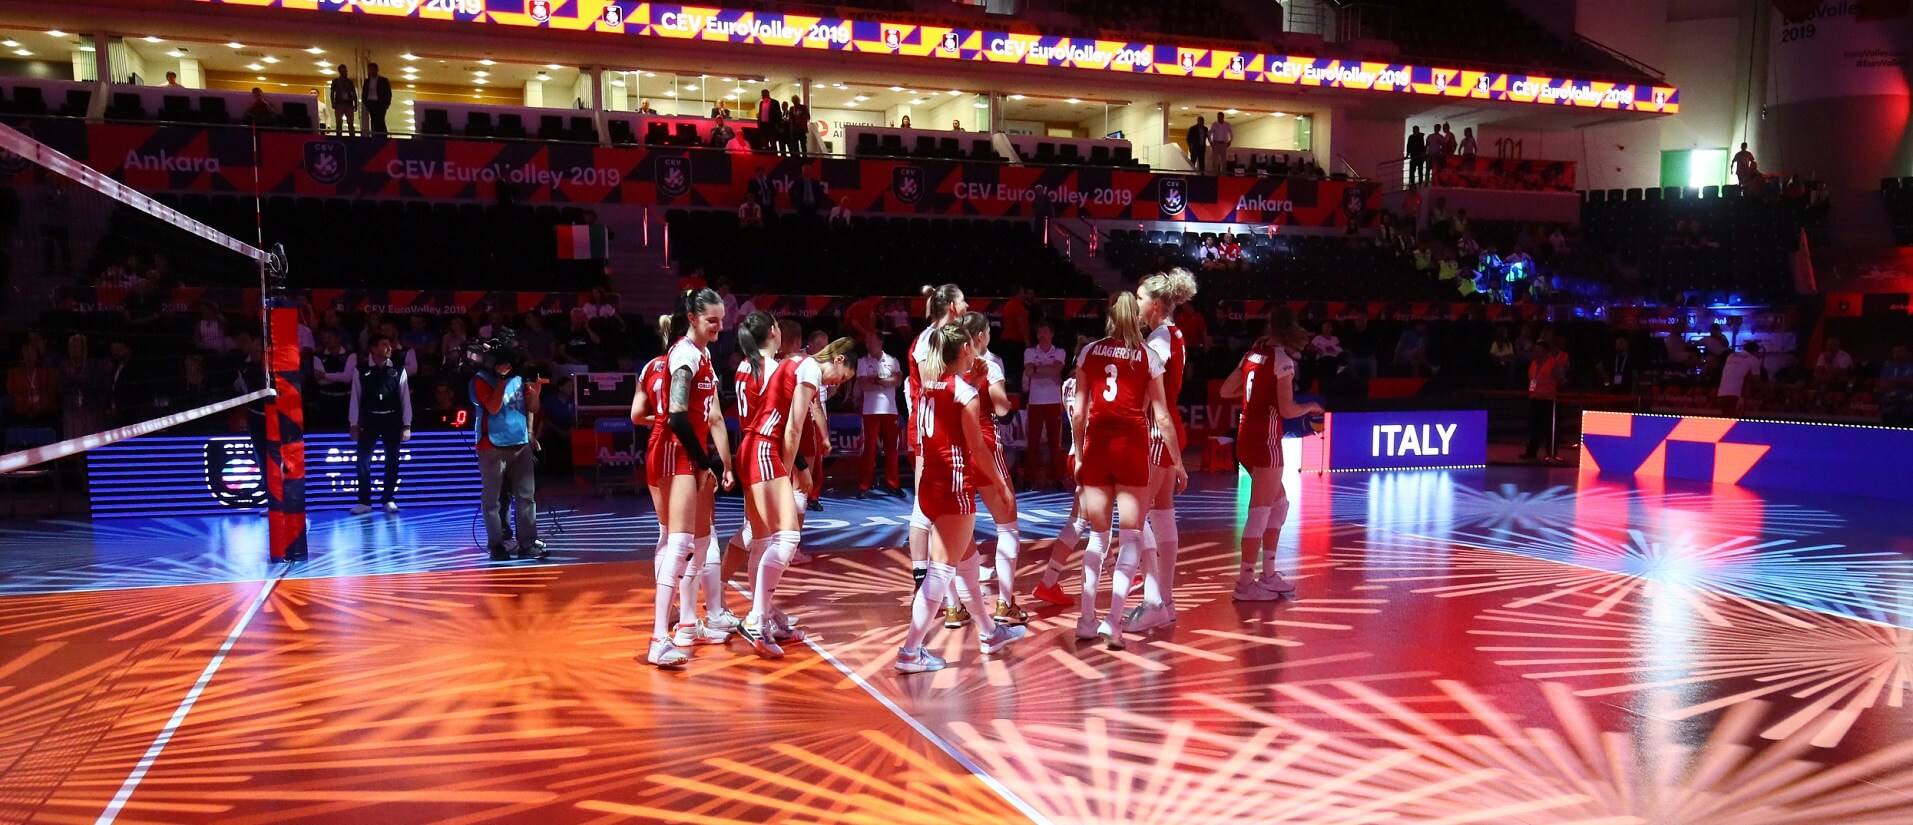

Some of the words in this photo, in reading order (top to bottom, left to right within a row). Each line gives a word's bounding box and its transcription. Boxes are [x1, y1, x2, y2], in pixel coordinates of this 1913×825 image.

[426, 0, 482, 15] 2019
[661, 12, 702, 32] CEV
[706, 17, 803, 45] EuroVolley
[808, 24, 850, 44] 2019
[1782, 24, 1816, 42] 2019
[990, 38, 1028, 56] CEV
[1028, 44, 1113, 68] EuroVolley
[1115, 49, 1152, 67] 2019
[1271, 60, 1303, 78] CEV
[1302, 64, 1376, 87] EuroVolley
[1378, 69, 1410, 86] 2019
[1512, 80, 1540, 97] CEV
[1540, 84, 1604, 106] EuroVolley
[1605, 88, 1633, 105] 2019
[314, 143, 334, 152] CEV
[1494, 137, 1523, 160] 101
[124, 149, 221, 174] Ankara
[386, 160, 436, 181] CEV
[571, 167, 621, 187] 2019
[665, 159, 682, 168] CEV
[901, 168, 916, 176] CEV
[954, 182, 992, 201] CEV
[1093, 189, 1132, 206] 2019
[1166, 180, 1180, 188] CEV
[1236, 193, 1293, 213] Ankara
[363, 304, 386, 314] CEV
[387, 304, 442, 316] EuroVolley
[443, 305, 468, 315] 2019
[1102, 363, 1119, 402] 3
[734, 379, 749, 419] 15
[1372, 423, 1457, 457] ITALY
